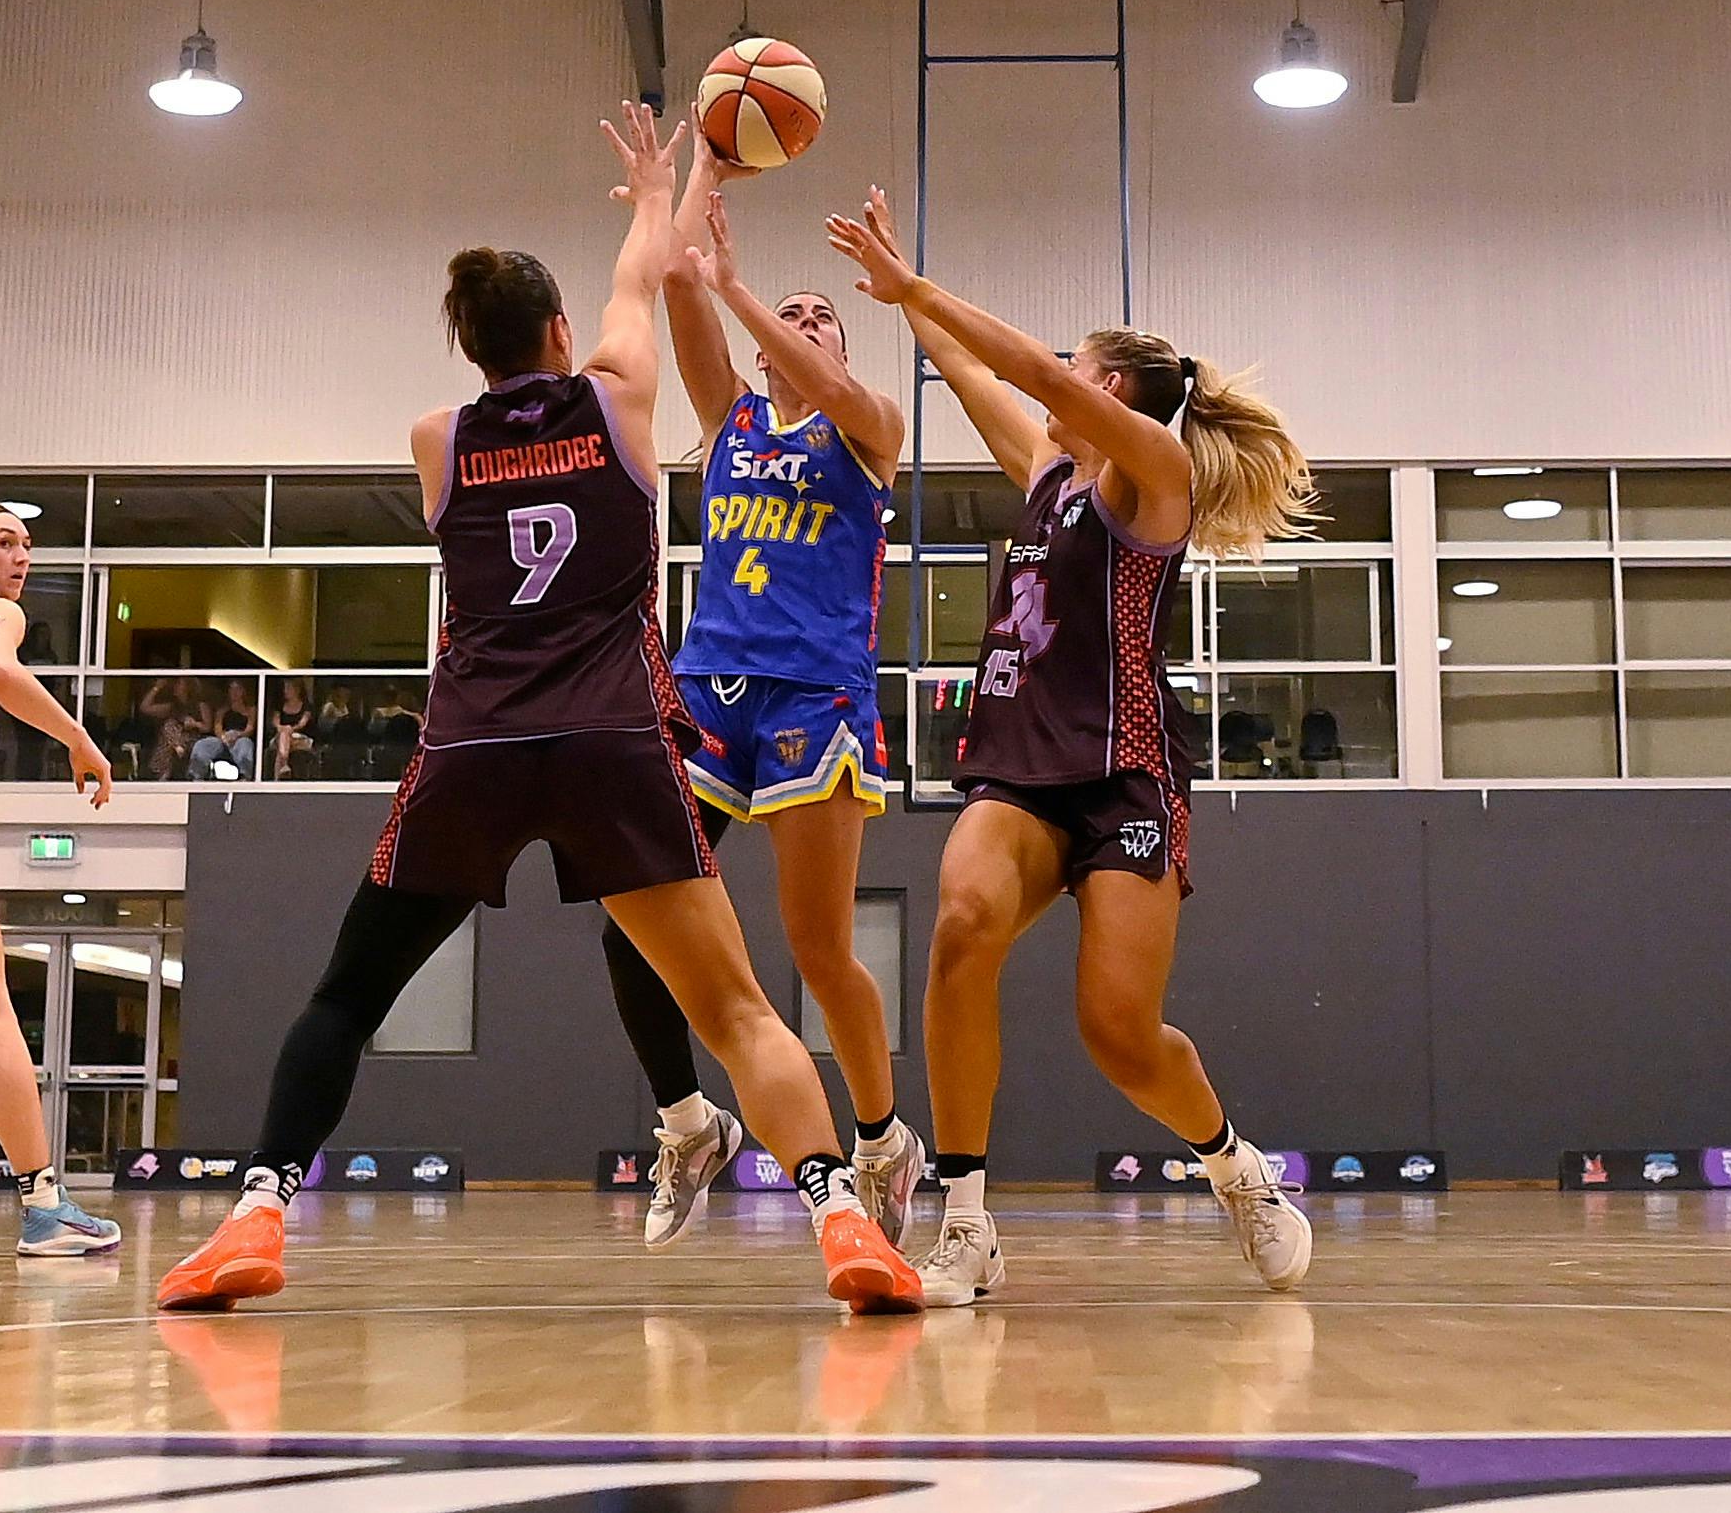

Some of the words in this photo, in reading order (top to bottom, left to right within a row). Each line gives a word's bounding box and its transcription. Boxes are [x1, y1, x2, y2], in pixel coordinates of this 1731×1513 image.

[459, 434, 606, 487] LOUGHRIDGE
[707, 493, 836, 546] SPIRIT
[507, 502, 578, 606] 9
[732, 547, 771, 596] 4
[979, 648, 1021, 699] 15
